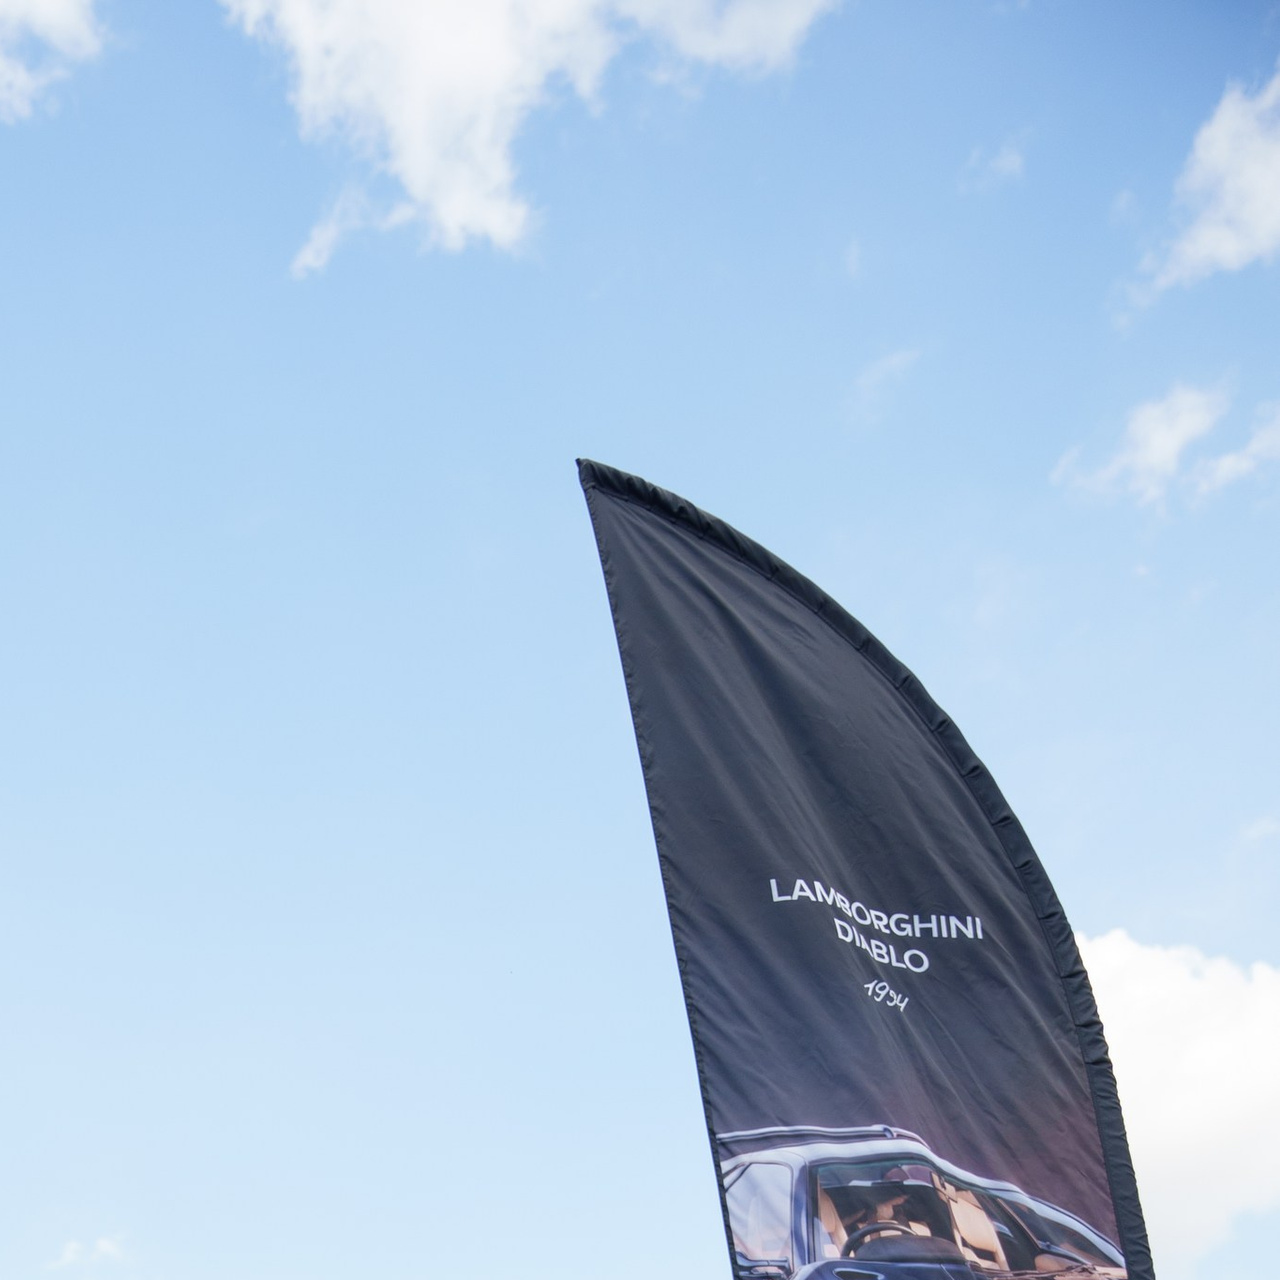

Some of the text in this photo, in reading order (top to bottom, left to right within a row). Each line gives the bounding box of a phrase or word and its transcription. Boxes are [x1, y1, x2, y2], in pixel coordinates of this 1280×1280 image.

[770, 878, 983, 939] LAMBORGHINI
[834, 917, 929, 973] DIABLO
[864, 979, 909, 1011] 1994
